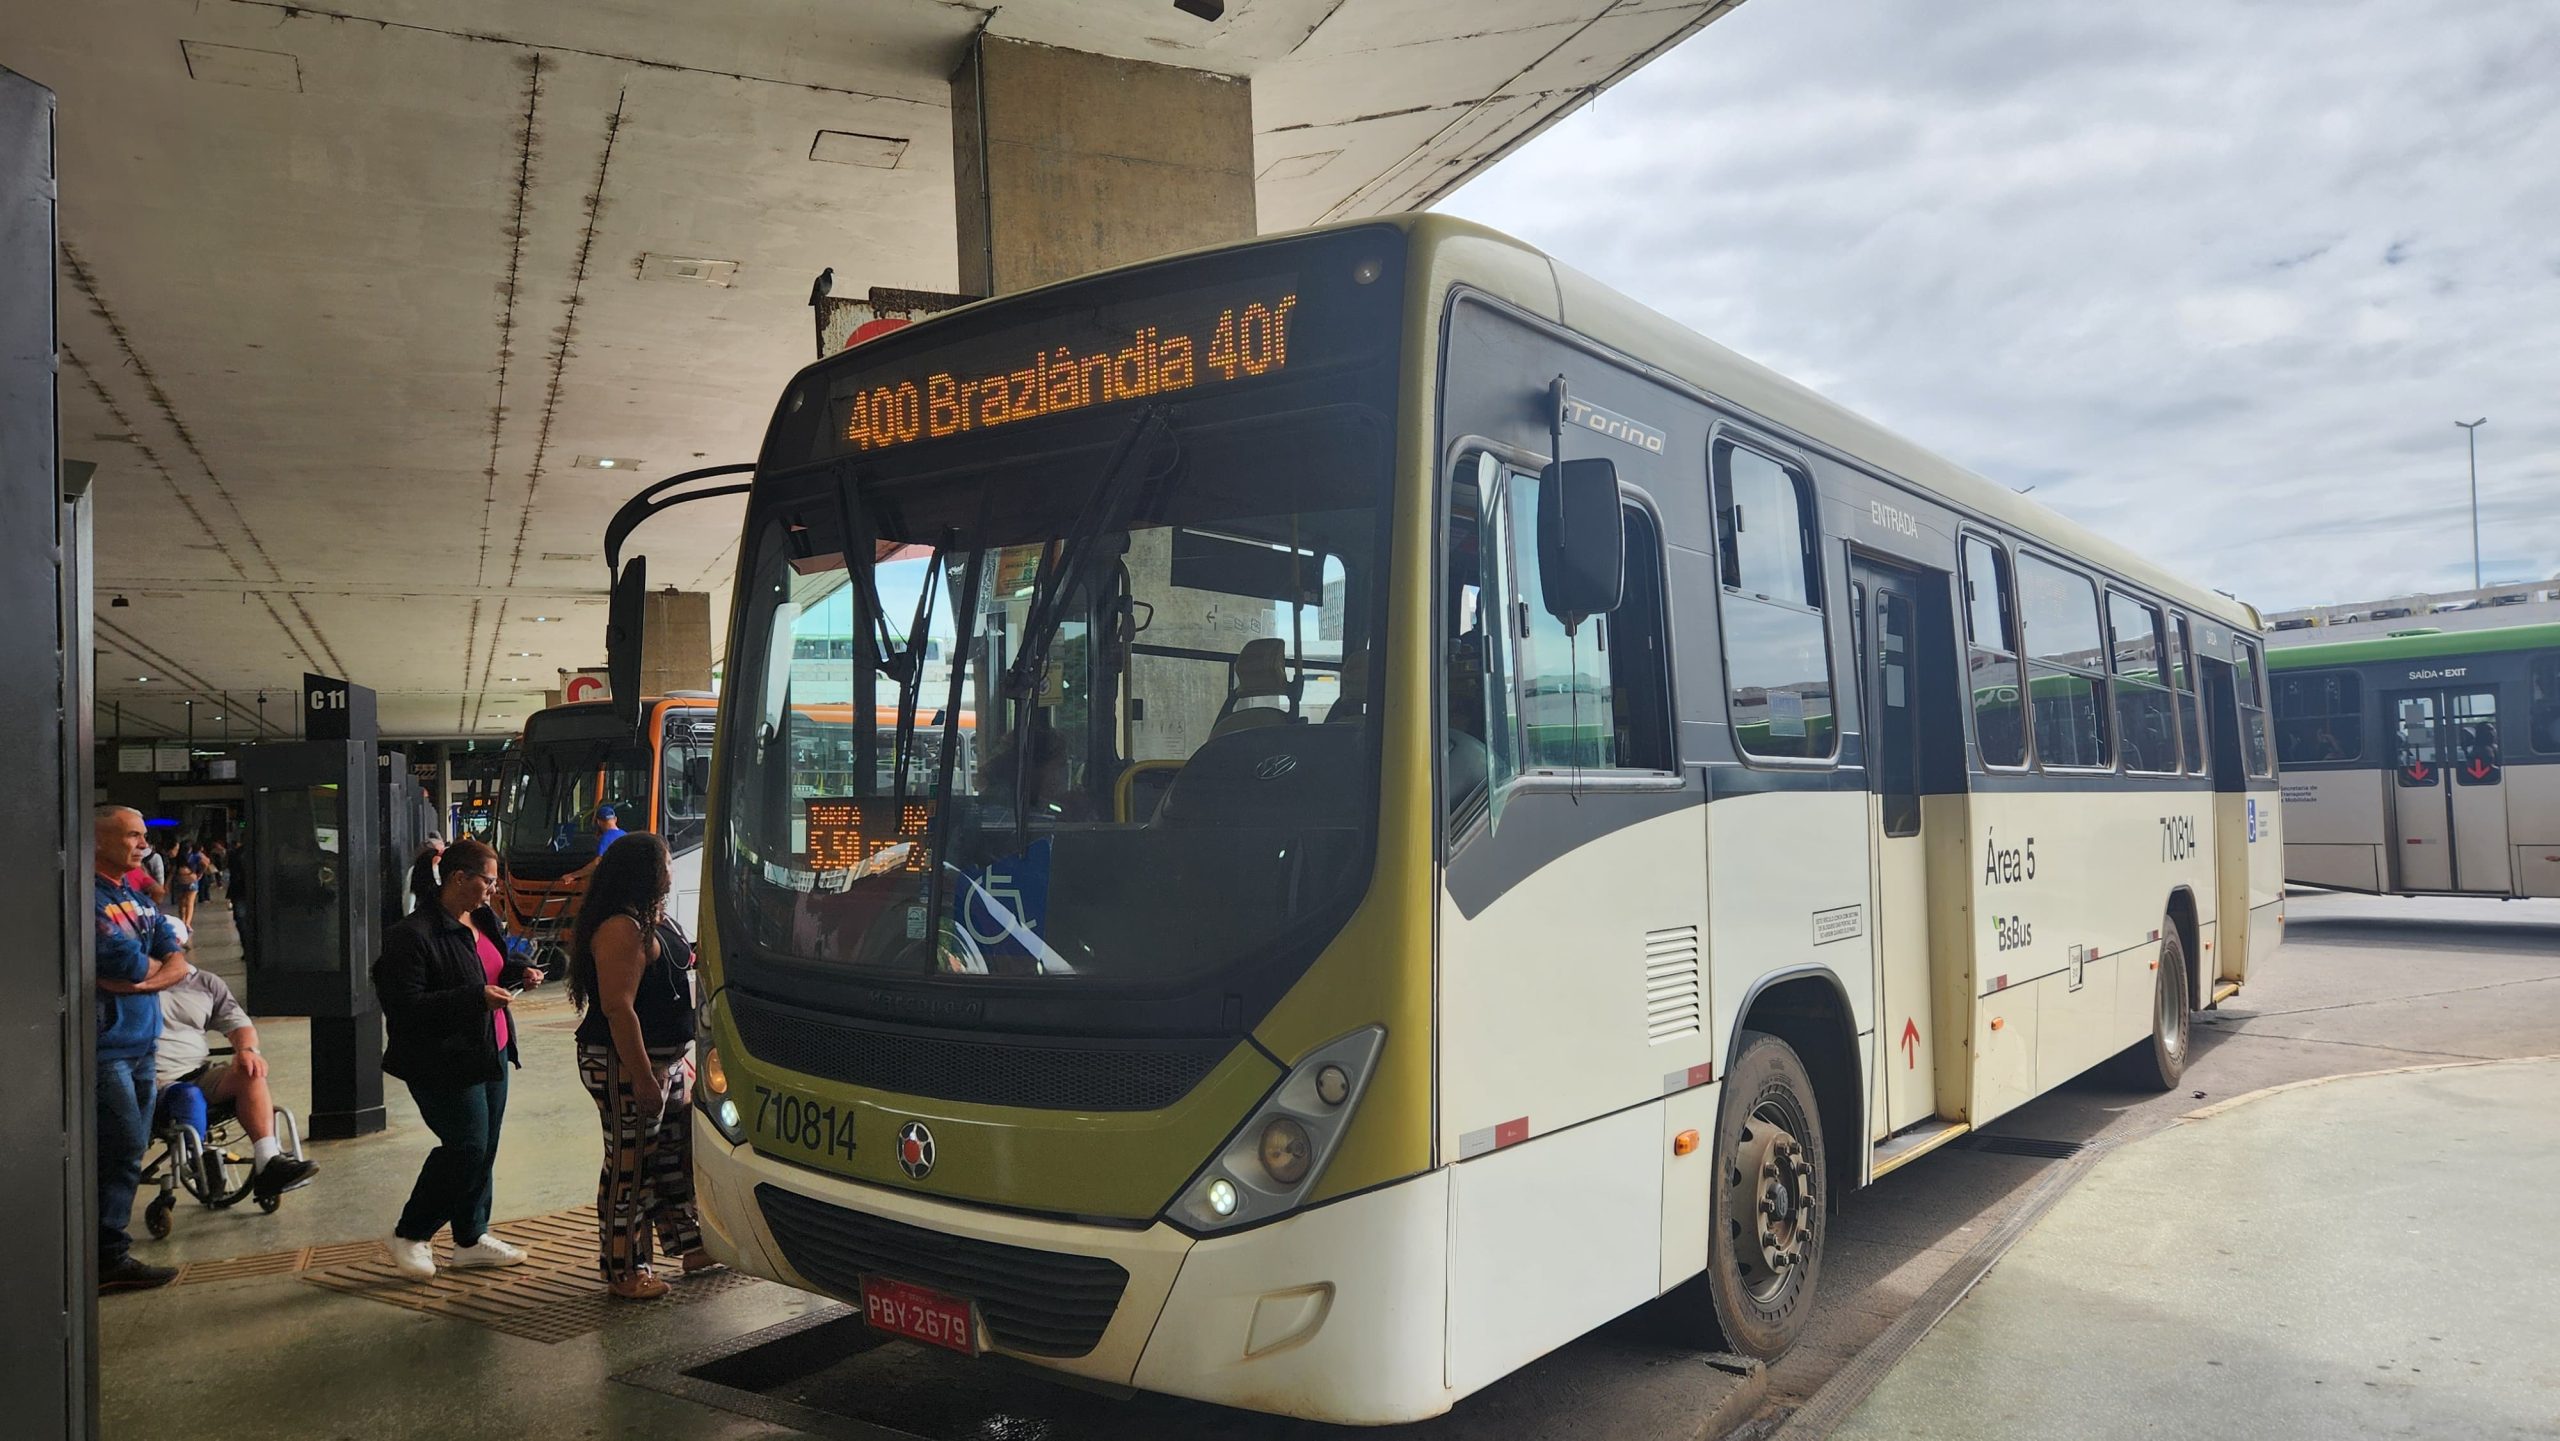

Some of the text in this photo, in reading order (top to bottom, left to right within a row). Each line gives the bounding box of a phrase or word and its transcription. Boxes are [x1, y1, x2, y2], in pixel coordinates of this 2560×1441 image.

[847, 381, 920, 450] 400
[929, 326, 1193, 437] Brazlândia
[1569, 400, 1662, 451] Torino
[1871, 500, 1918, 539] ENTRADA
[2409, 668, 2467, 680] SAÍDA EXIT
[311, 690, 346, 710] C 11
[1985, 826, 2036, 886] Área 5
[2159, 815, 2195, 863] 710814
[1997, 915, 2032, 952] BsBus
[755, 1084, 857, 1161] 710814
